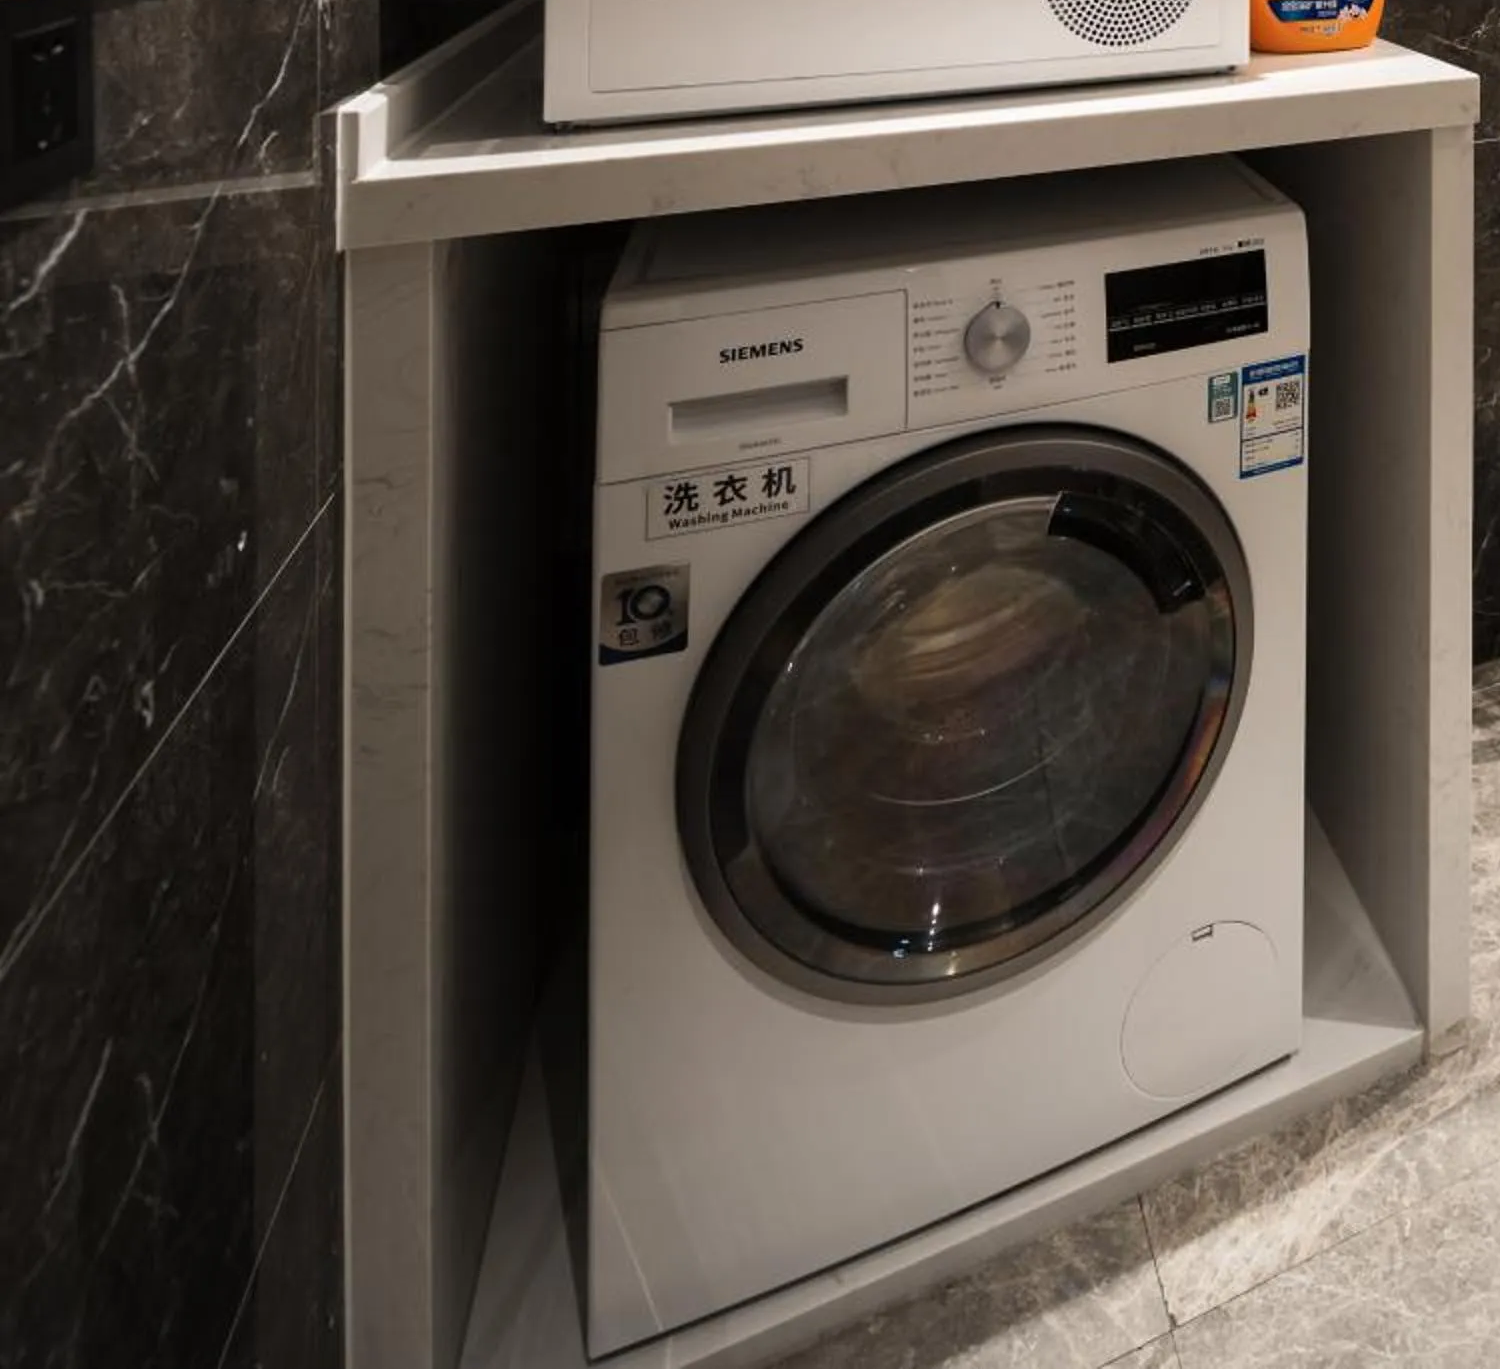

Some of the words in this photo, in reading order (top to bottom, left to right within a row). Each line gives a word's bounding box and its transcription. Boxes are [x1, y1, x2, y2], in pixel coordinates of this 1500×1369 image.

[719, 338, 805, 364] SIEMENS
[663, 466, 797, 516] 洗衣机
[669, 507, 729, 531] Washing
[730, 500, 789, 519] Machine
[615, 584, 671, 626] 10
